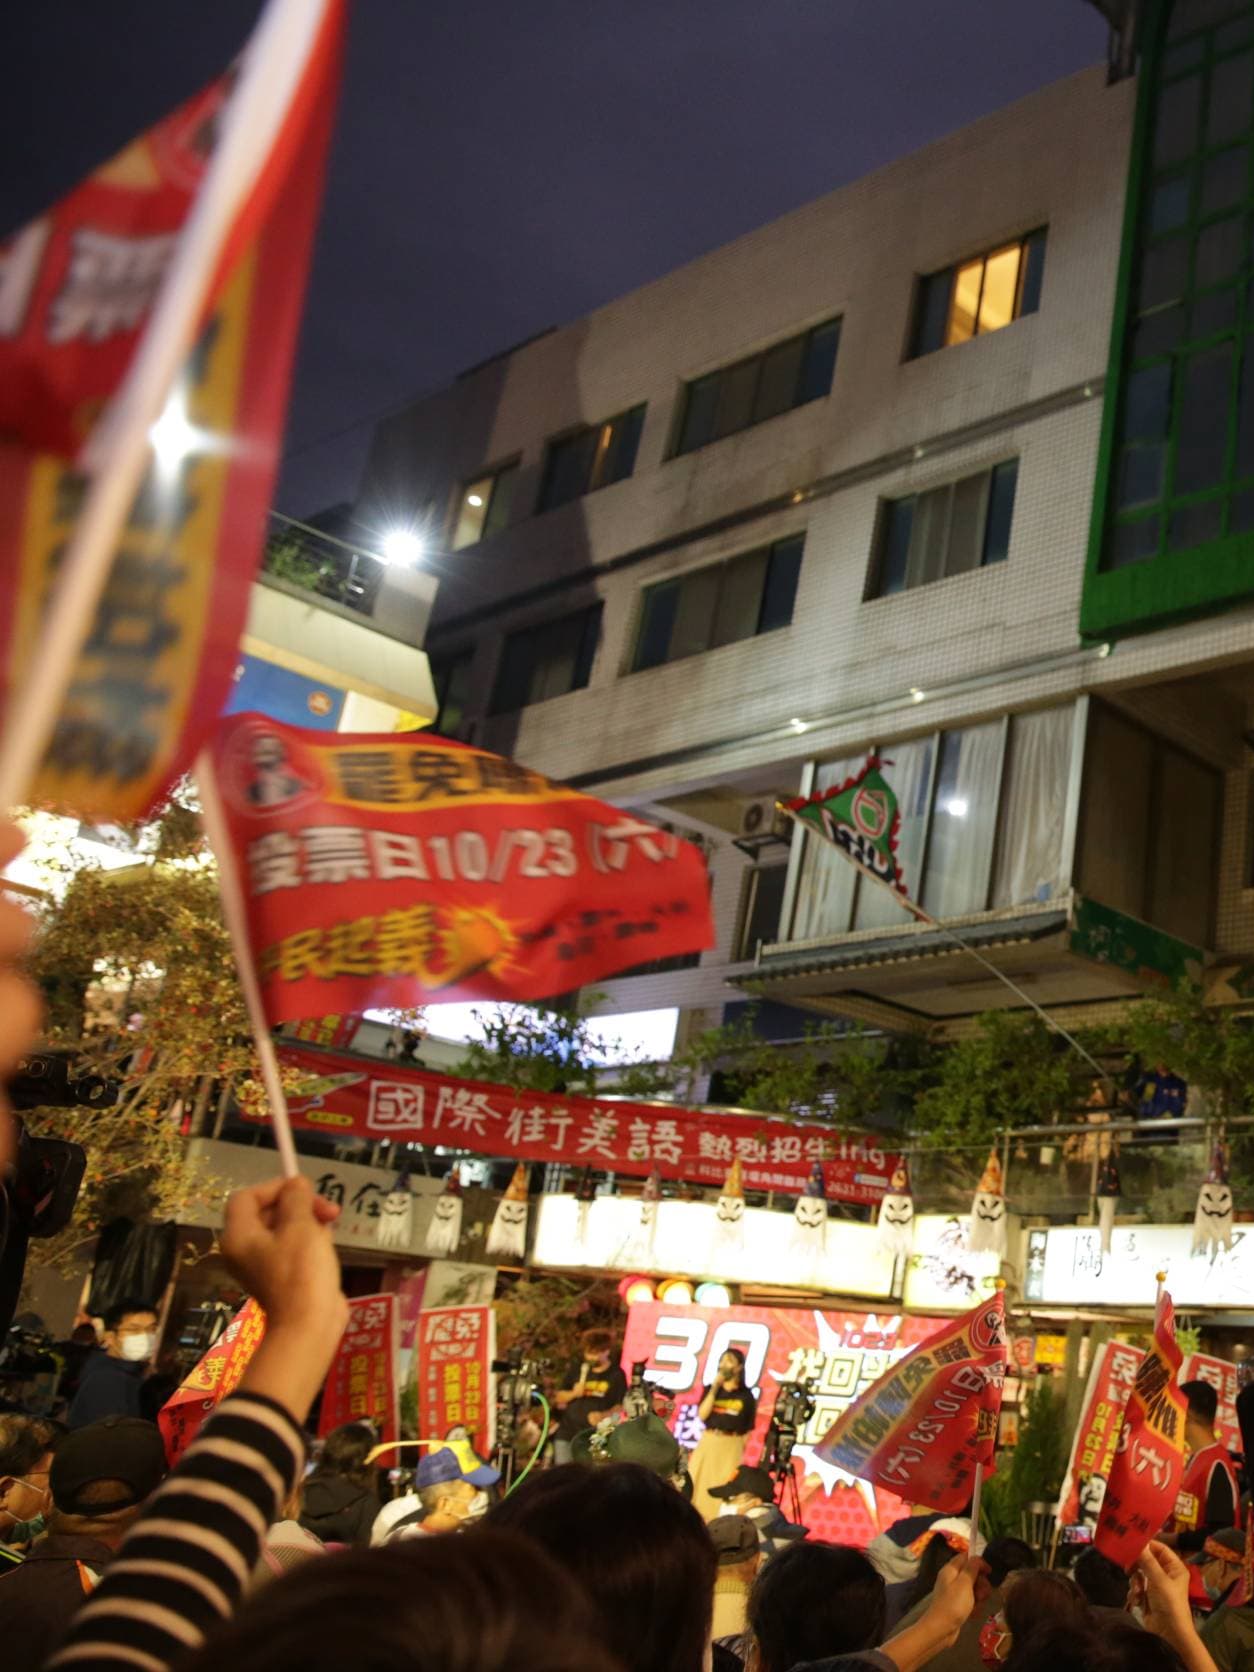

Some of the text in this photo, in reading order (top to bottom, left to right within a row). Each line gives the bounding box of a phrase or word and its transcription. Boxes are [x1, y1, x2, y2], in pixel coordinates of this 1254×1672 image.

[367, 1080, 684, 1164] 國際街美語
